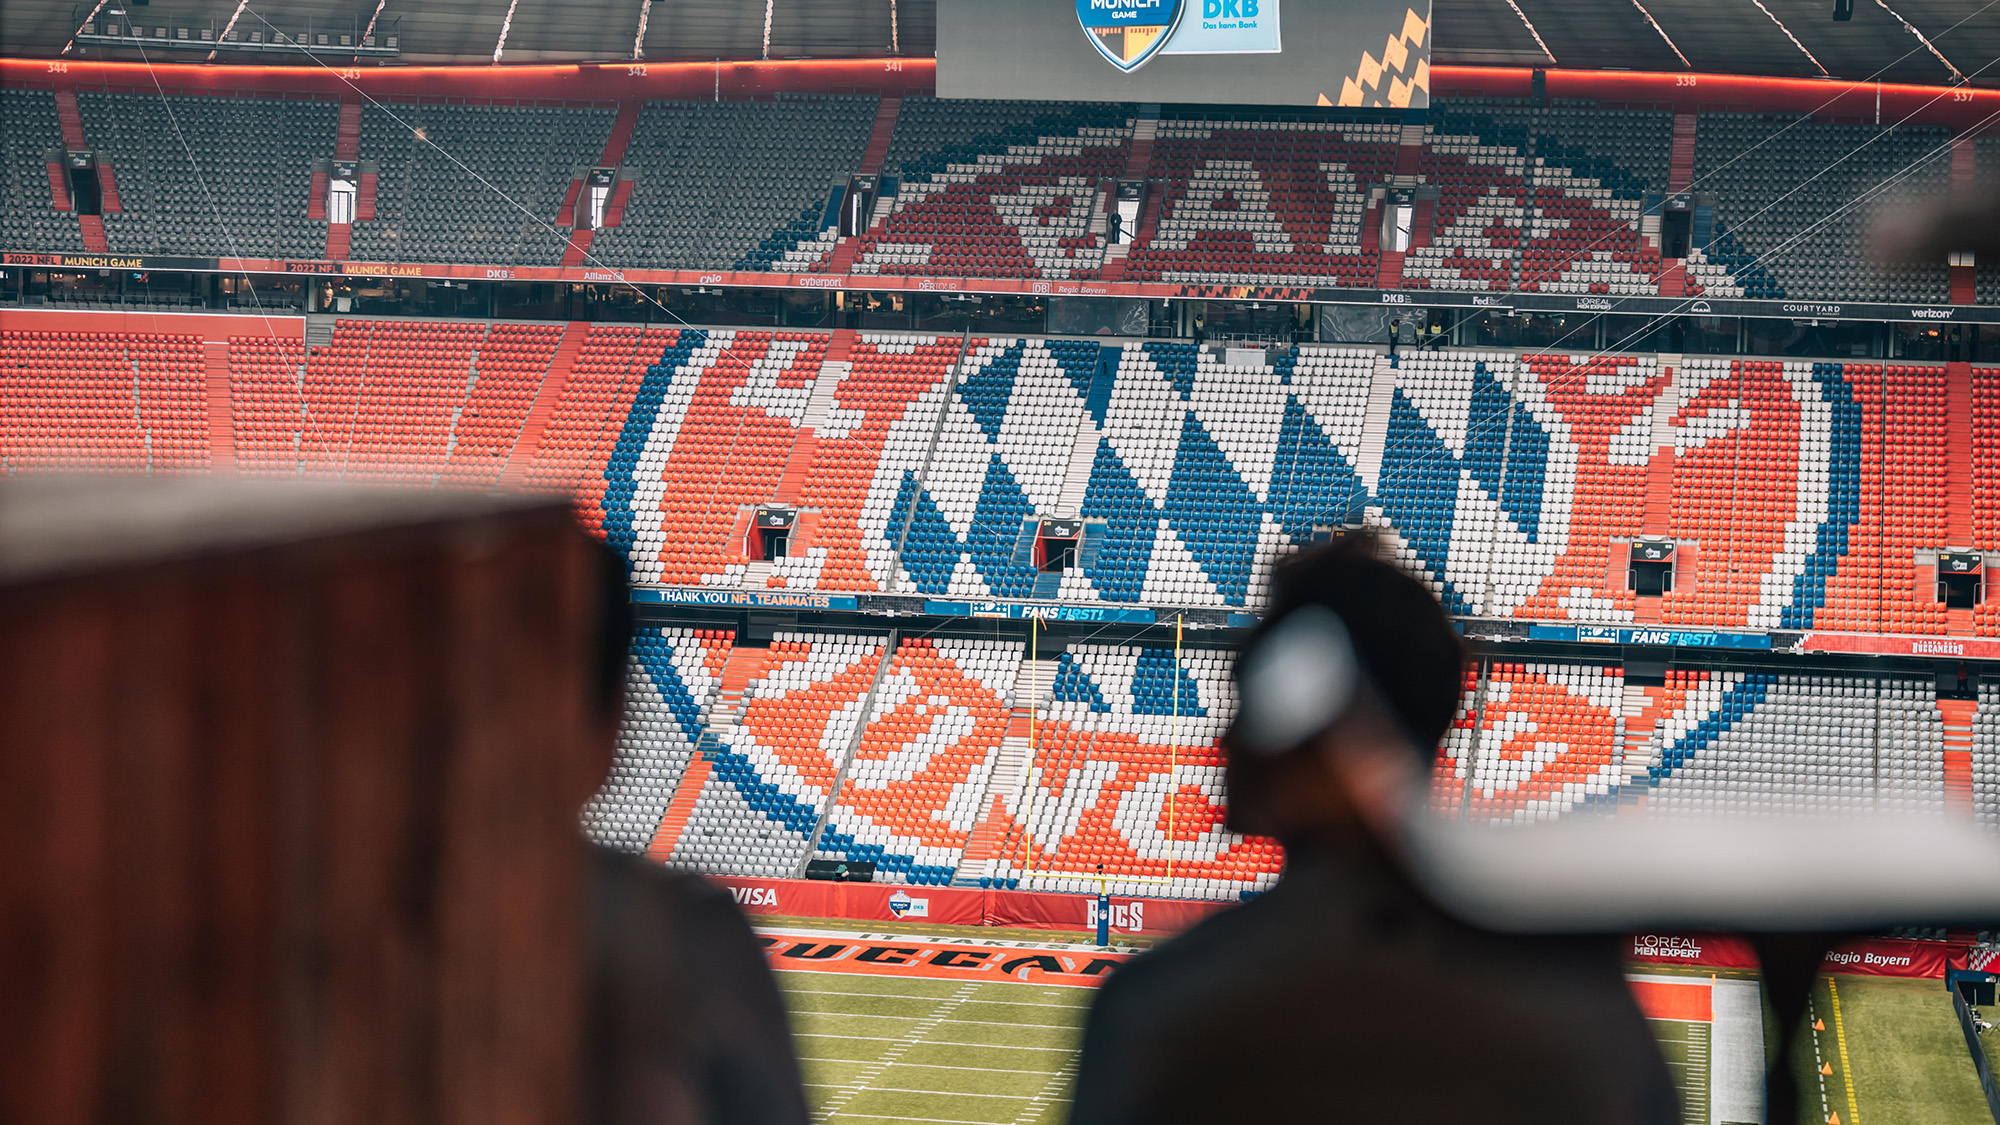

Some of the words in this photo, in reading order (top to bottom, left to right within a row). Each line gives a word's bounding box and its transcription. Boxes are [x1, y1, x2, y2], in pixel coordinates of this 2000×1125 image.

[1112, 11, 1137, 19] GAME
[1202, 0, 1260, 19] DKB
[1219, 21, 1237, 29] kann
[1239, 21, 1257, 29] Bank
[47, 62, 68, 74] 344
[627, 66, 648, 77] 342
[884, 61, 902, 72] 341
[341, 68, 361, 80] 343
[1676, 75, 1697, 87] 338
[1953, 91, 1975, 102] 337
[9, 255, 33, 265] 2022
[37, 256, 57, 266] NFL
[64, 256, 108, 267] MUNICH
[110, 258, 143, 268] GAME
[291, 263, 316, 274] 2022
[318, 264, 338, 274] NFL
[346, 265, 388, 276] MUNICH
[390, 266, 422, 276] GAME
[486, 270, 508, 279] DKB
[584, 272, 613, 281] Allianz
[799, 277, 842, 288] cyberport
[1034, 284, 1048, 293] DB
[1058, 285, 1079, 295] Regio
[1081, 287, 1107, 296] Bayern
[1382, 294, 1405, 303] DKB
[1783, 304, 1840, 313] COURTYARD
[1911, 308, 1950, 318] verizon
[659, 591, 701, 603] THANK
[702, 593, 728, 604] YOU
[731, 594, 754, 605] NFL
[756, 595, 830, 608] TEAMMATES
[1912, 642, 1964, 656] BUCCANEERS
[727, 886, 778, 906] VISA
[859, 933, 903, 941] IT
[926, 936, 1070, 950] TAKES
[1634, 935, 1702, 949] L'ORÉAL
[1634, 947, 1659, 956] MEN
[1660, 948, 1702, 959] EXPERT
[1825, 951, 1861, 965] Regio
[1864, 952, 1911, 966] Bayern
